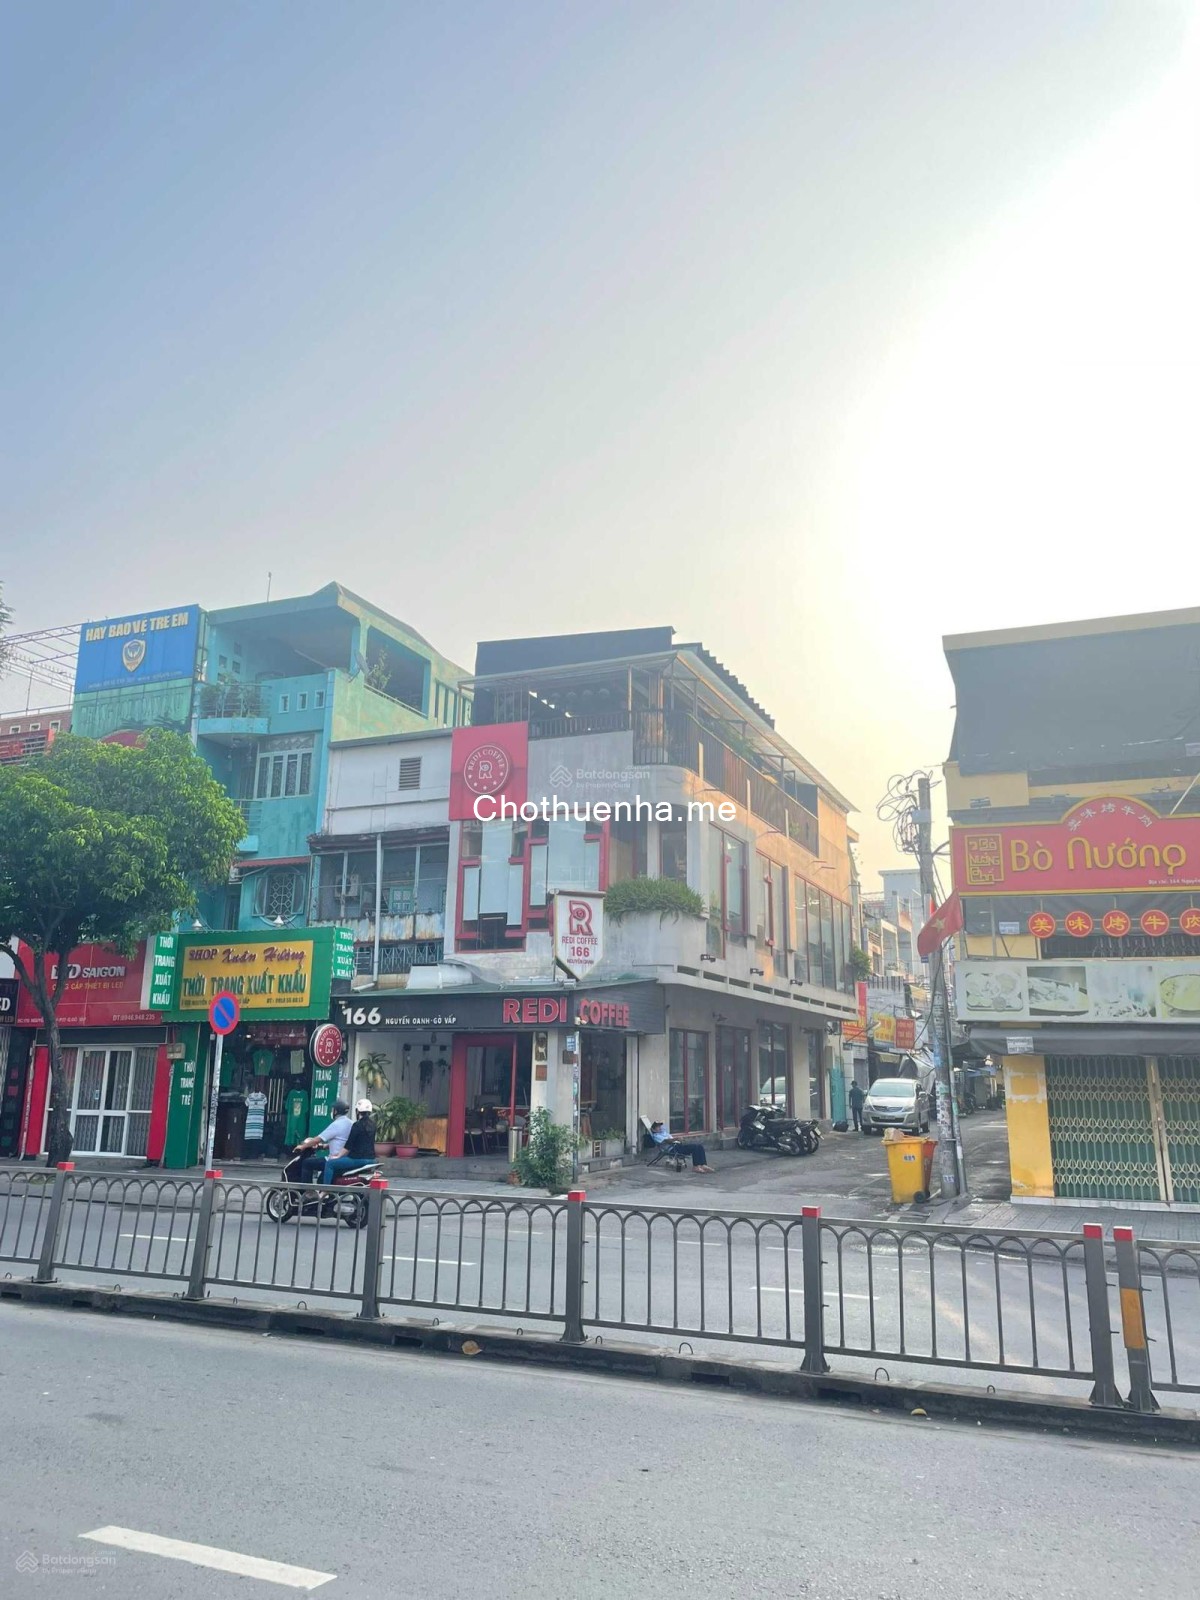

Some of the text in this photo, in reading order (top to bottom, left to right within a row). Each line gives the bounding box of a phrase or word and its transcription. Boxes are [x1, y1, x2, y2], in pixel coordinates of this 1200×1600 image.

[171, 612, 189, 627] EM
[1010, 839, 1053, 872] Bò
[561, 936, 598, 946] REDI COFFEE
[188, 948, 219, 960] SHOP
[571, 946, 590, 958] 166
[155, 954, 175, 967] TRANG
[81, 966, 126, 979] SAIGON
[112, 981, 124, 989] LED
[211, 975, 246, 996] TRANG
[247, 967, 276, 995] XUẤT
[342, 1007, 381, 1025] 166
[385, 1015, 410, 1025] NGUYỄN
[445, 1013, 456, 1024] VẤP
[503, 997, 630, 1028] REDI COFFEE
[315, 1070, 332, 1081] TRANG
